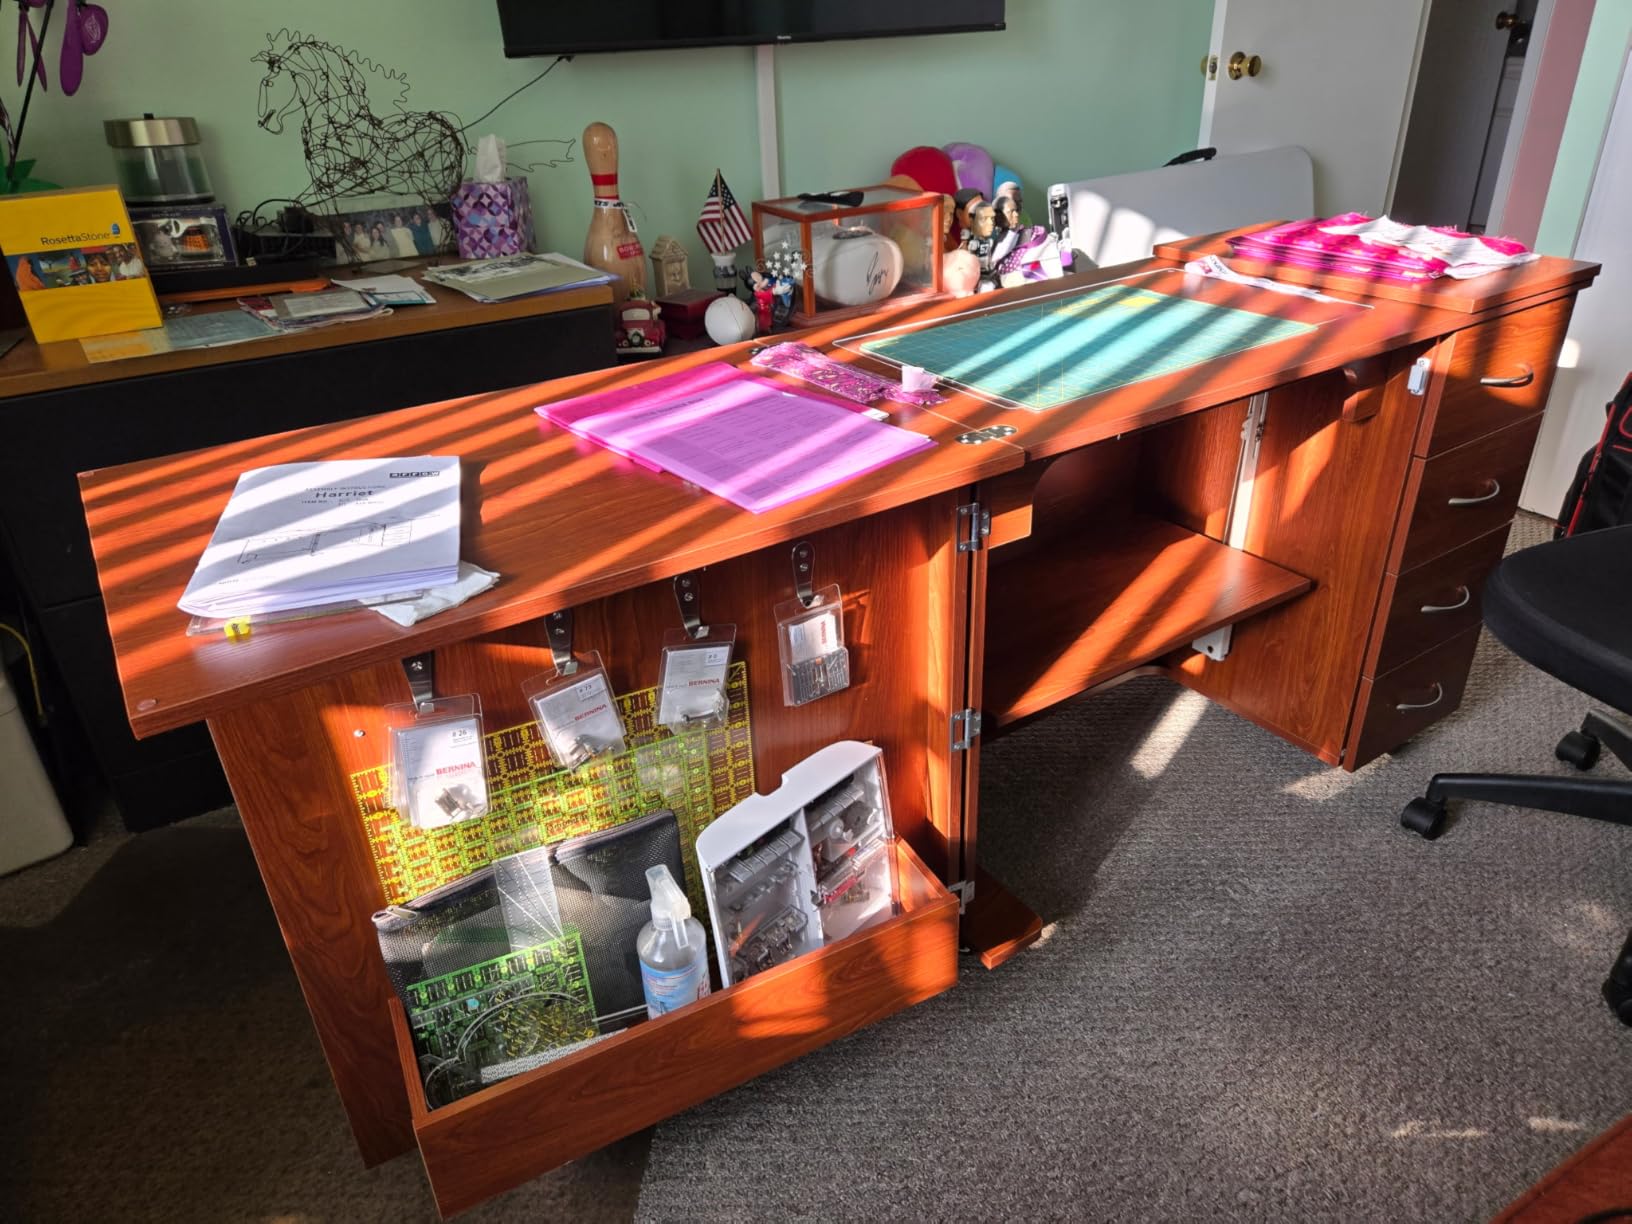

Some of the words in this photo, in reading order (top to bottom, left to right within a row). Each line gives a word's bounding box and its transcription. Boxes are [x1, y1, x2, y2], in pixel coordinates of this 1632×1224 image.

[40, 232, 110, 246] RosettaStone
[315, 490, 374, 498] Harriet
[688, 677, 720, 687] BERNINA
[574, 704, 607, 721] BERNINA
[458, 729, 468, 737] 26
[435, 761, 477, 775] BERNINA
